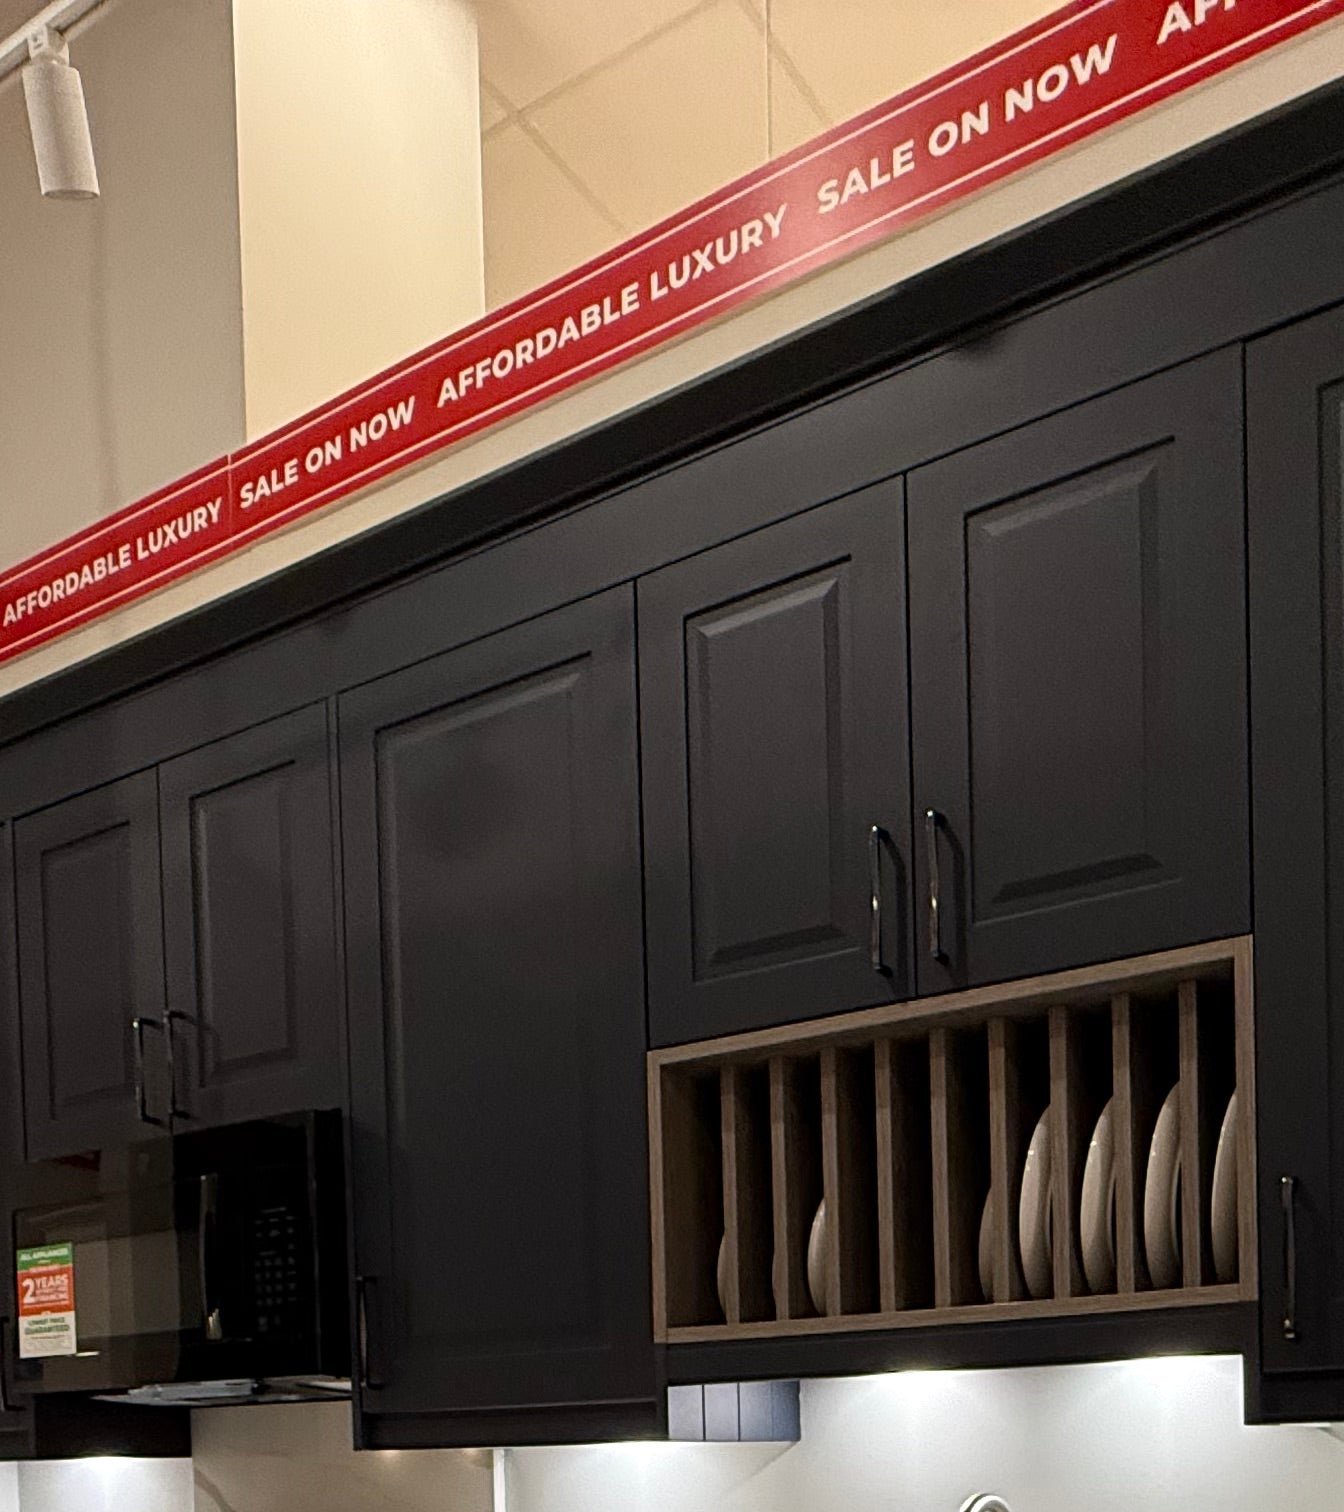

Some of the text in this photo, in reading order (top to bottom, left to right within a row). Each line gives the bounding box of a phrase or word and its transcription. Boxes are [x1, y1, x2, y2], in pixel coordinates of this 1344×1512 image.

[815, 34, 1118, 215] SALE ON NOW
[437, 204, 788, 409] AFFORDABLE LUXURY
[239, 396, 415, 509] SALE ON NOW
[3, 497, 222, 627] AFFORDABLE LUXURY
[22, 1278, 36, 1303] 2
[35, 1273, 68, 1288] YEARS
